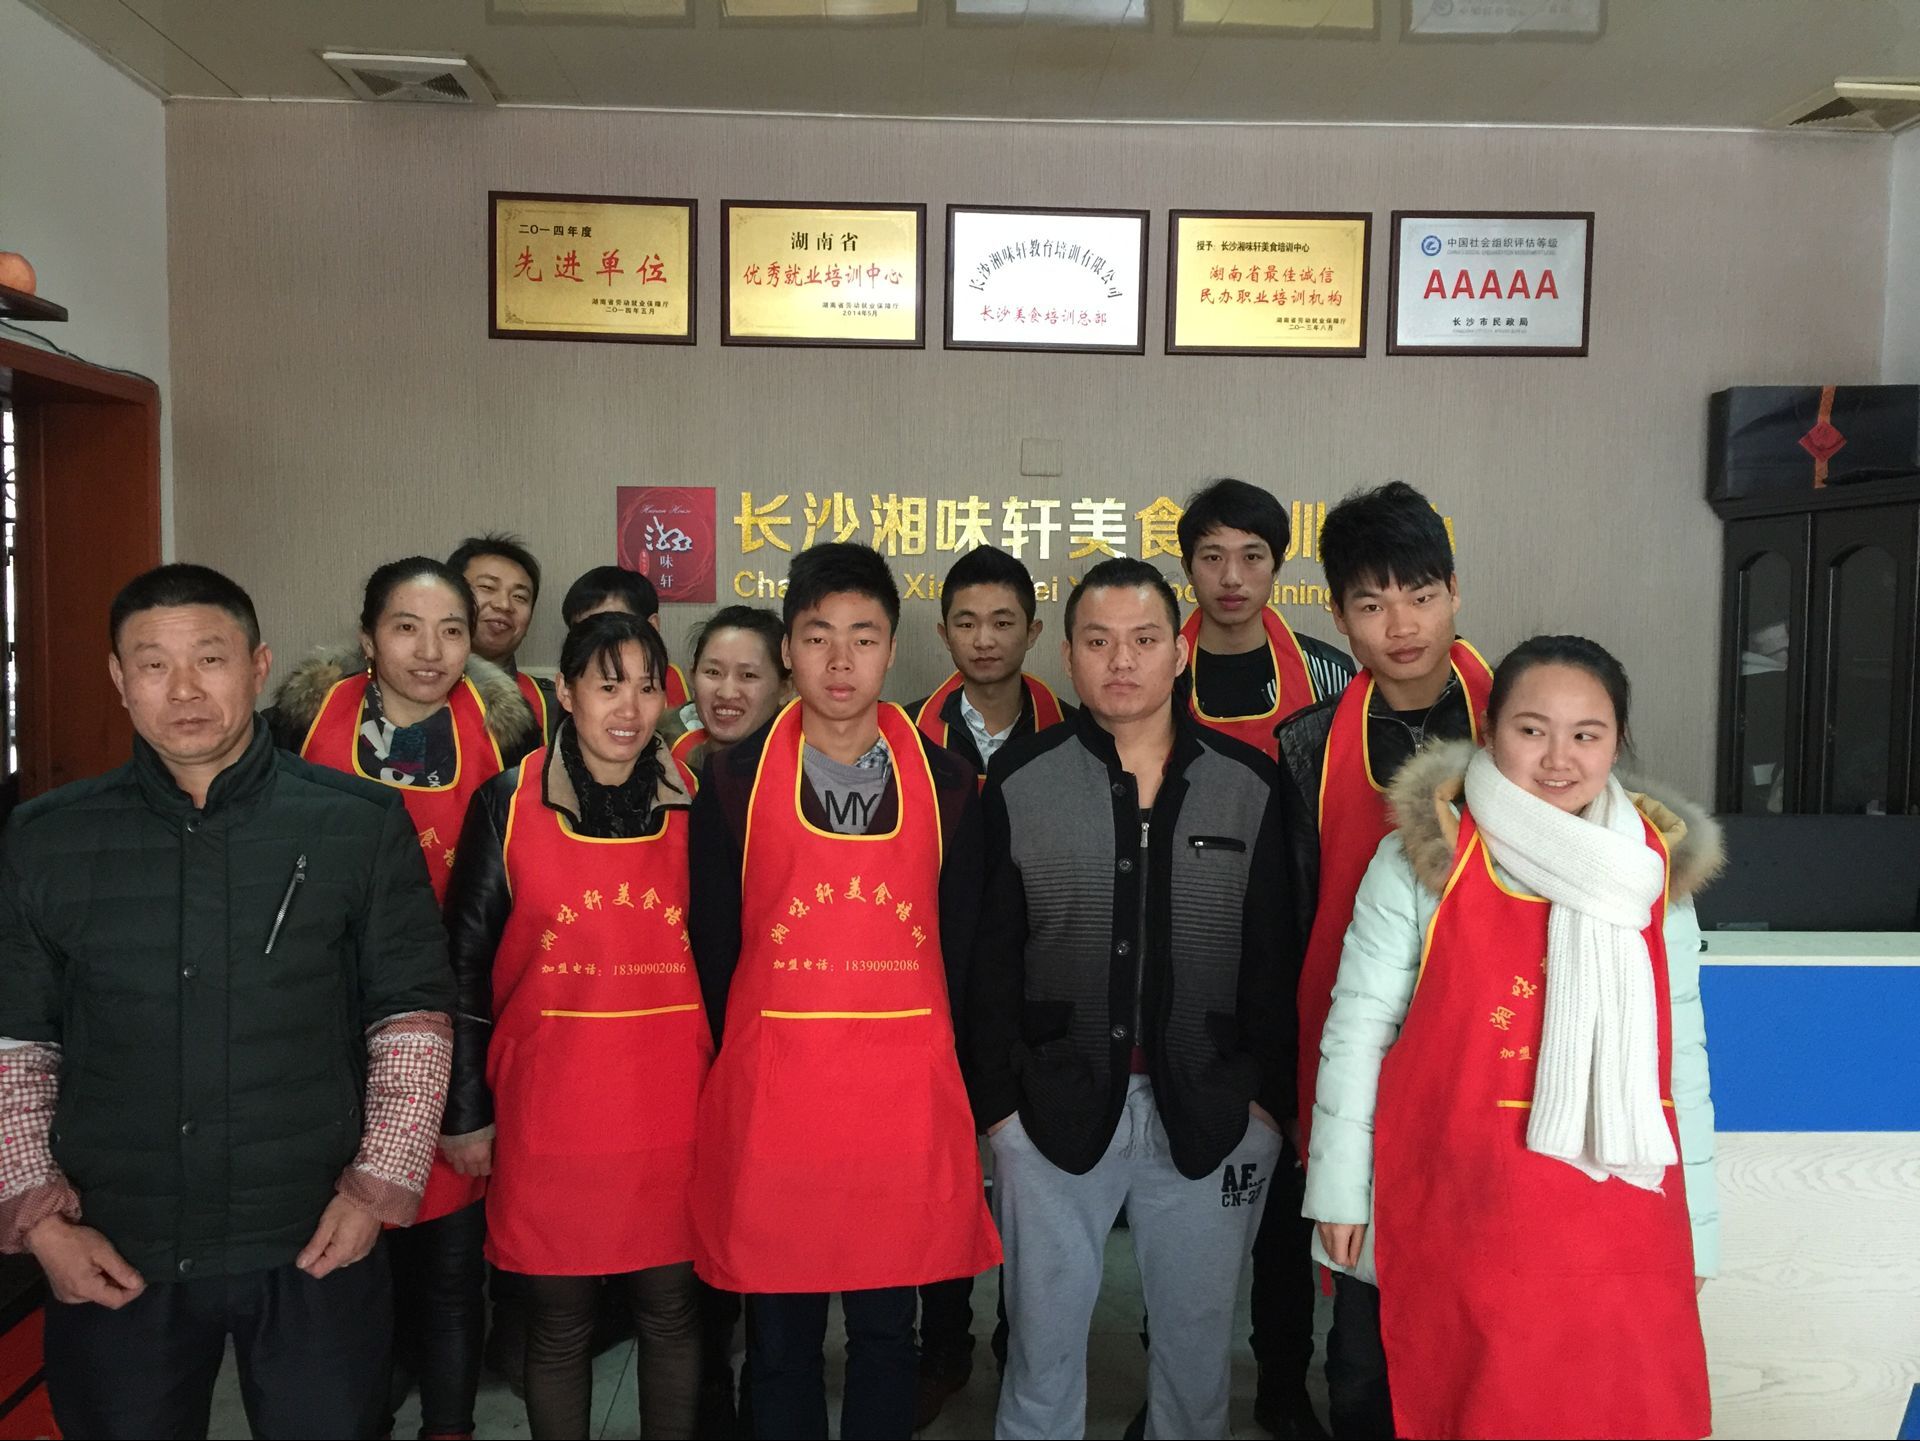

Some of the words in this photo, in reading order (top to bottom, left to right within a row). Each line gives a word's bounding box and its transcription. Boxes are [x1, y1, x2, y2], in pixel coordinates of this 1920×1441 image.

[790, 231, 858, 251] 湖南省
[1221, 241, 1310, 253] 长沙湘味轩美食培训中心
[1447, 237, 1558, 248] 中国社会组织评估等级
[513, 245, 667, 286] 先进单位
[743, 261, 903, 288] 优秀就业培训中心
[969, 239, 1123, 299] 长沙湘味轩教育培训有限公司
[1209, 265, 1335, 283] 湖南省最佳诚信
[1423, 269, 1559, 299] AAAAA
[1200, 288, 1343, 307] 民办职业培训机构
[980, 304, 1107, 326] 长沙美食培训总部
[1453, 317, 1528, 326] 长沙市民政局
[771, 875, 927, 948] 湘味轩美食培训
[613, 962, 687, 976] 18390902086
[845, 960, 919, 972] 18390902086
